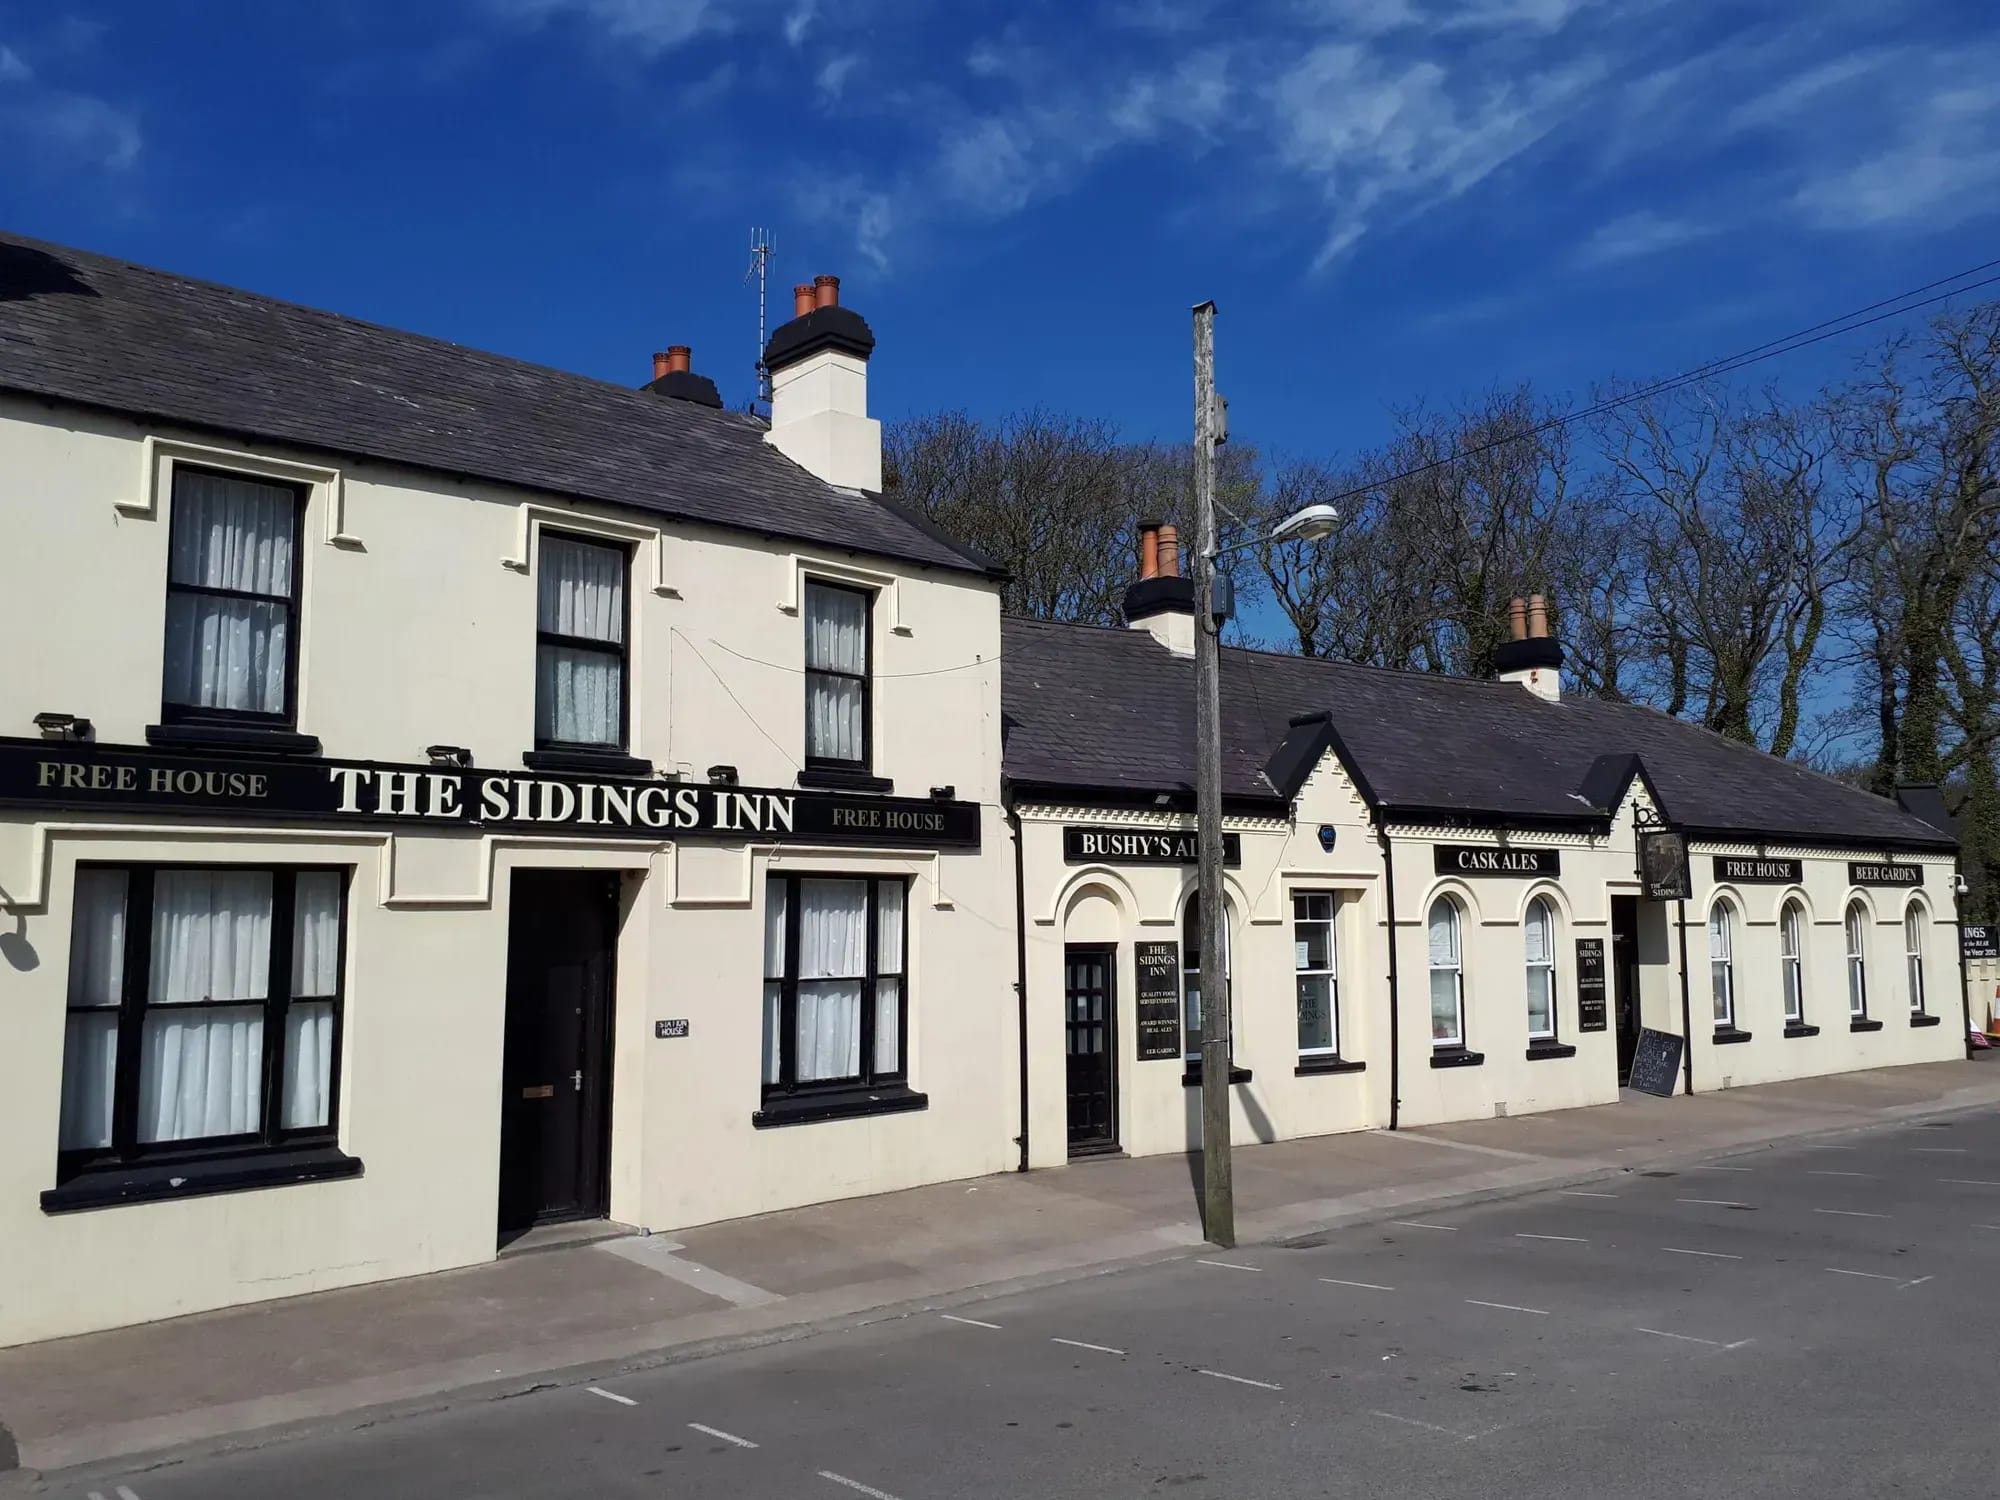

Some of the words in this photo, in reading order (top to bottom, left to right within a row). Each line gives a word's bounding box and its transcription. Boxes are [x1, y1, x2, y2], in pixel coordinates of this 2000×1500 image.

[36, 761, 137, 791] FREE
[148, 768, 268, 798] HOUSE
[330, 767, 463, 818] THE
[480, 777, 699, 829] SIDINGS
[712, 792, 796, 833] INN
[832, 807, 880, 828] FREE
[885, 811, 944, 831] HOUSE
[1082, 833, 1171, 857] BUSHY'S
[1175, 838, 1225, 857] AL
[1458, 851, 1499, 869] CASK
[1502, 853, 1538, 870] ALES
[1727, 861, 1754, 876] FREE
[1757, 862, 1791, 877] HOUSE
[1856, 866, 1880, 880] BEER
[1881, 867, 1917, 881] GARDEN
[1148, 945, 1167, 955] THE
[1580, 950, 1602, 958] SIDINGS
[1139, 955, 1176, 965] SIDINGS
[1150, 966, 1166, 976] INN
